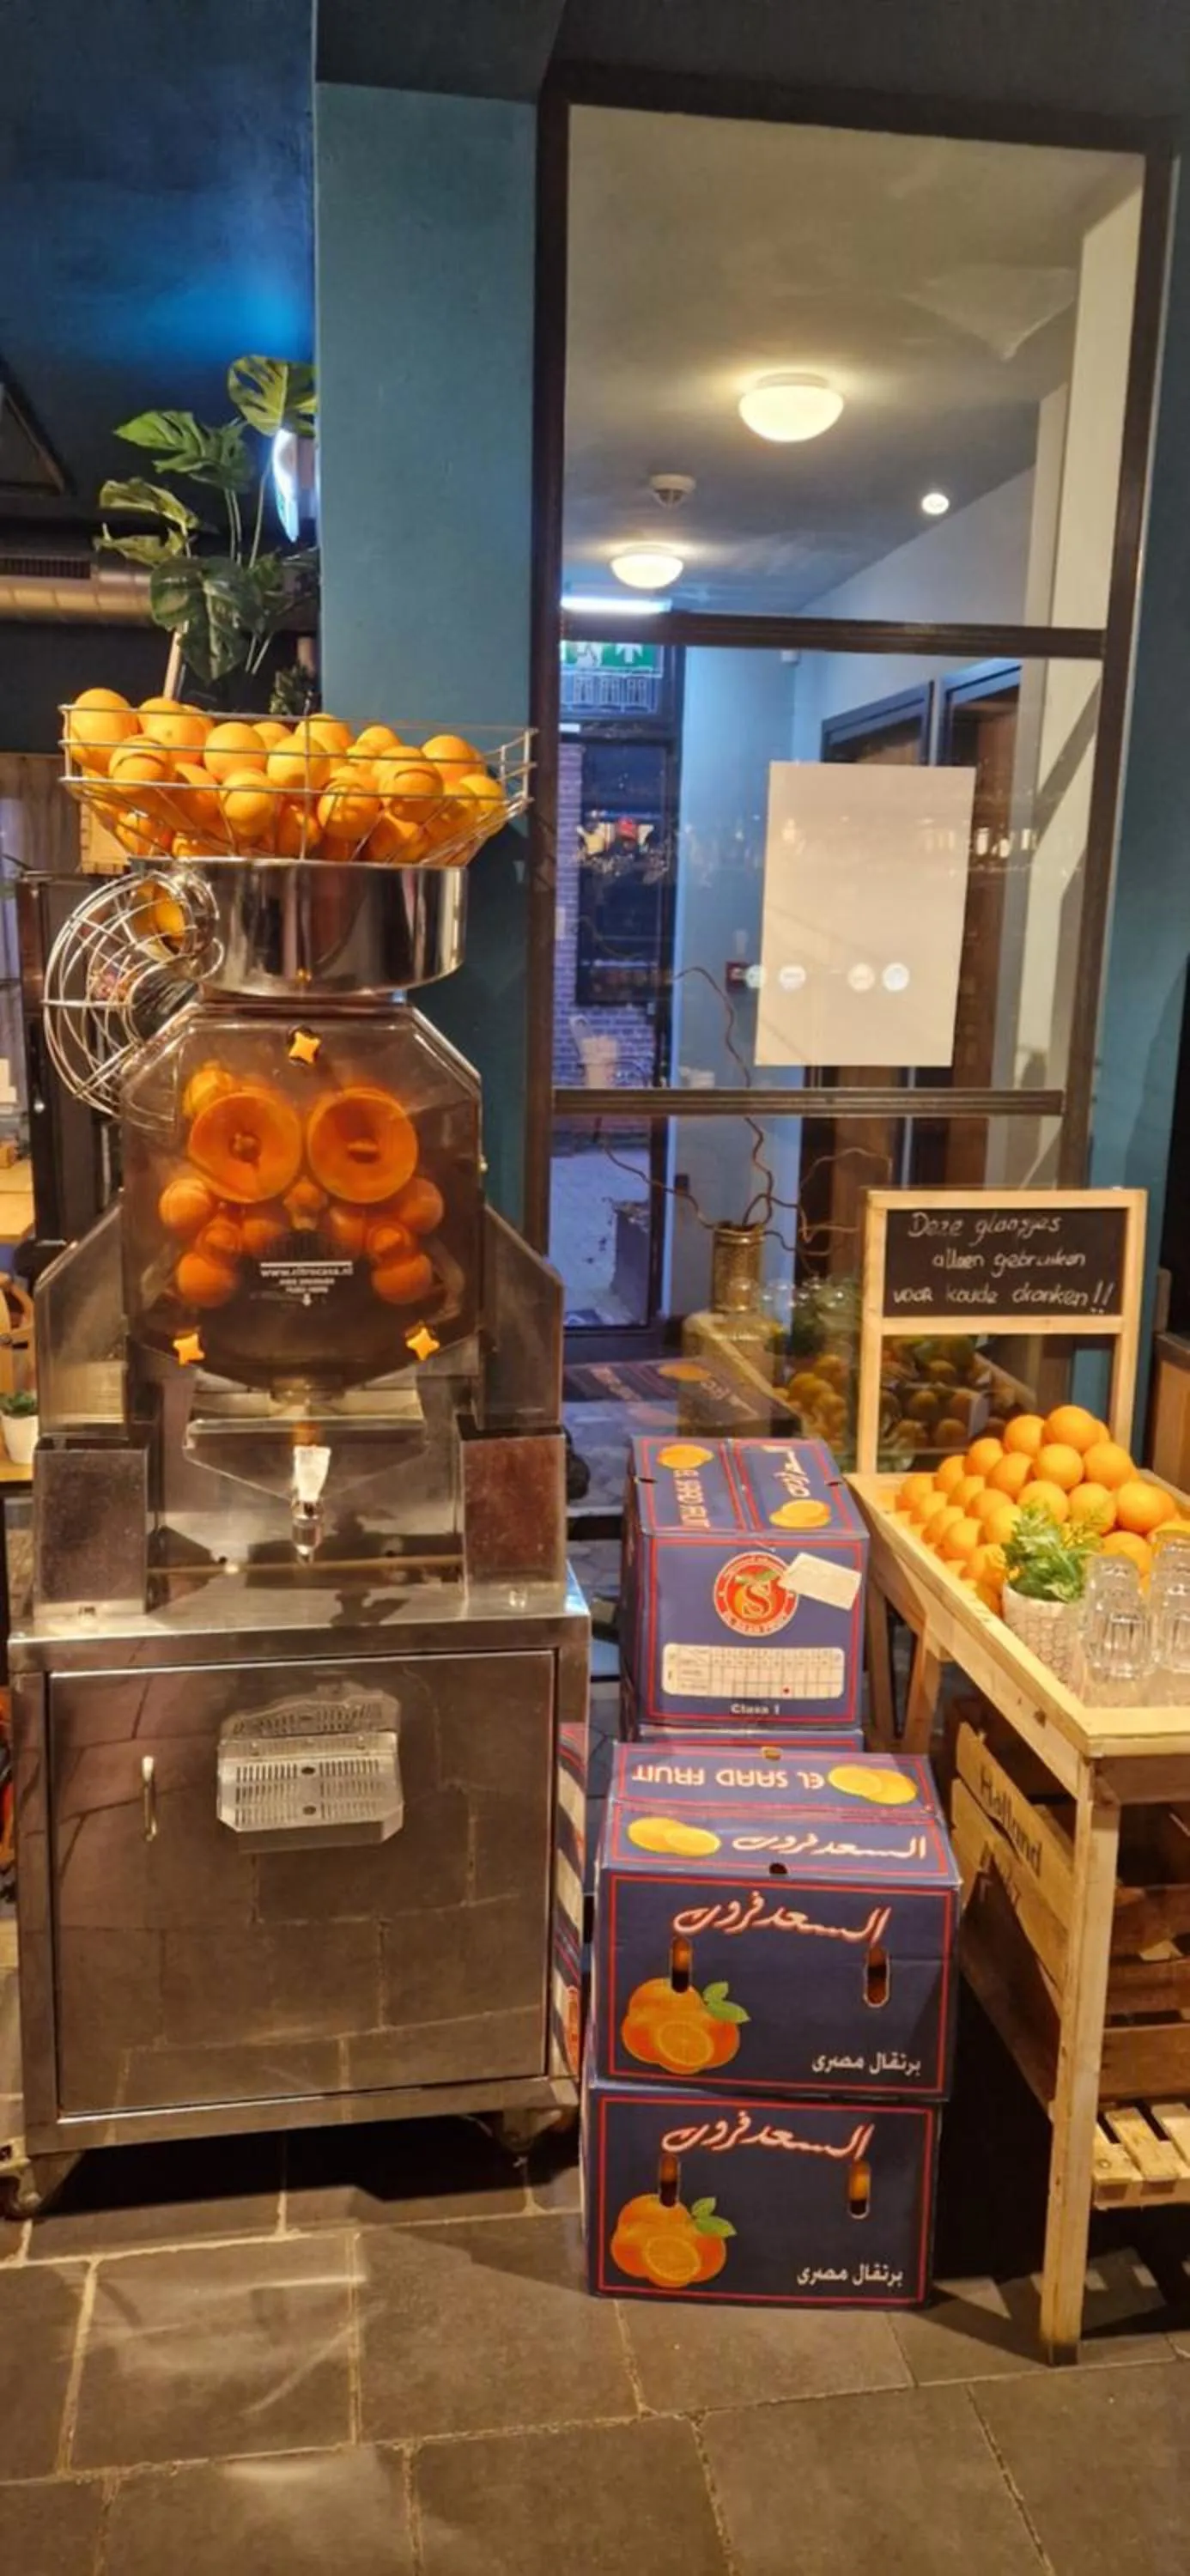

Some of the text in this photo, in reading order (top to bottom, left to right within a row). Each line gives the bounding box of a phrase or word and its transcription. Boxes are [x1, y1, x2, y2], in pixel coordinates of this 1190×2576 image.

[908, 1212, 963, 1237] Deze
[932, 1247, 1086, 1278] alleen gebruiken
[946, 1283, 998, 1303] koude
[631, 1765, 825, 1789] EL SAAD FRUIT
